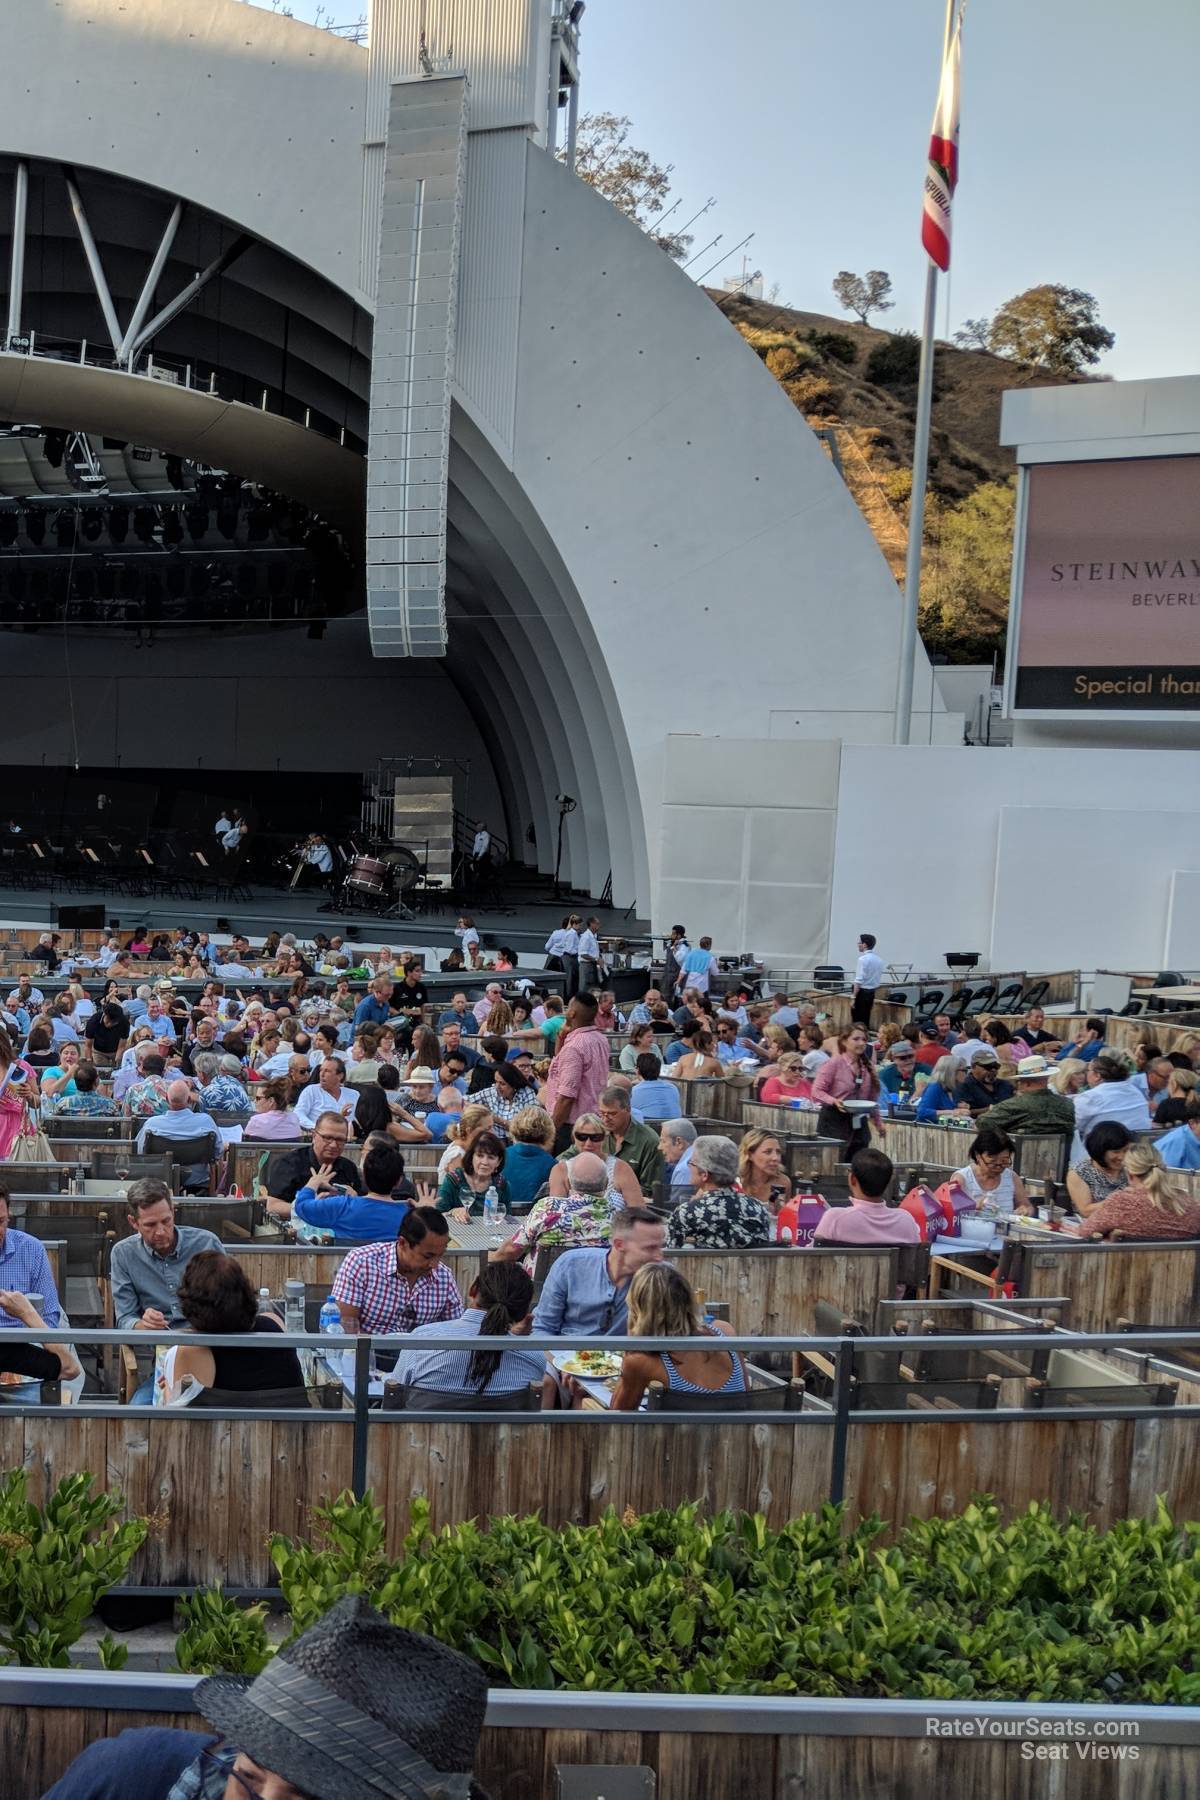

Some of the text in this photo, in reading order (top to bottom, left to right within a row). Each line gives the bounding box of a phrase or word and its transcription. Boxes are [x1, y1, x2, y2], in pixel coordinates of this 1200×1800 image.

[1051, 559, 1200, 582] STEINWAY
[1132, 592, 1200, 606] BEVERL
[1073, 674, 1152, 699] Special
